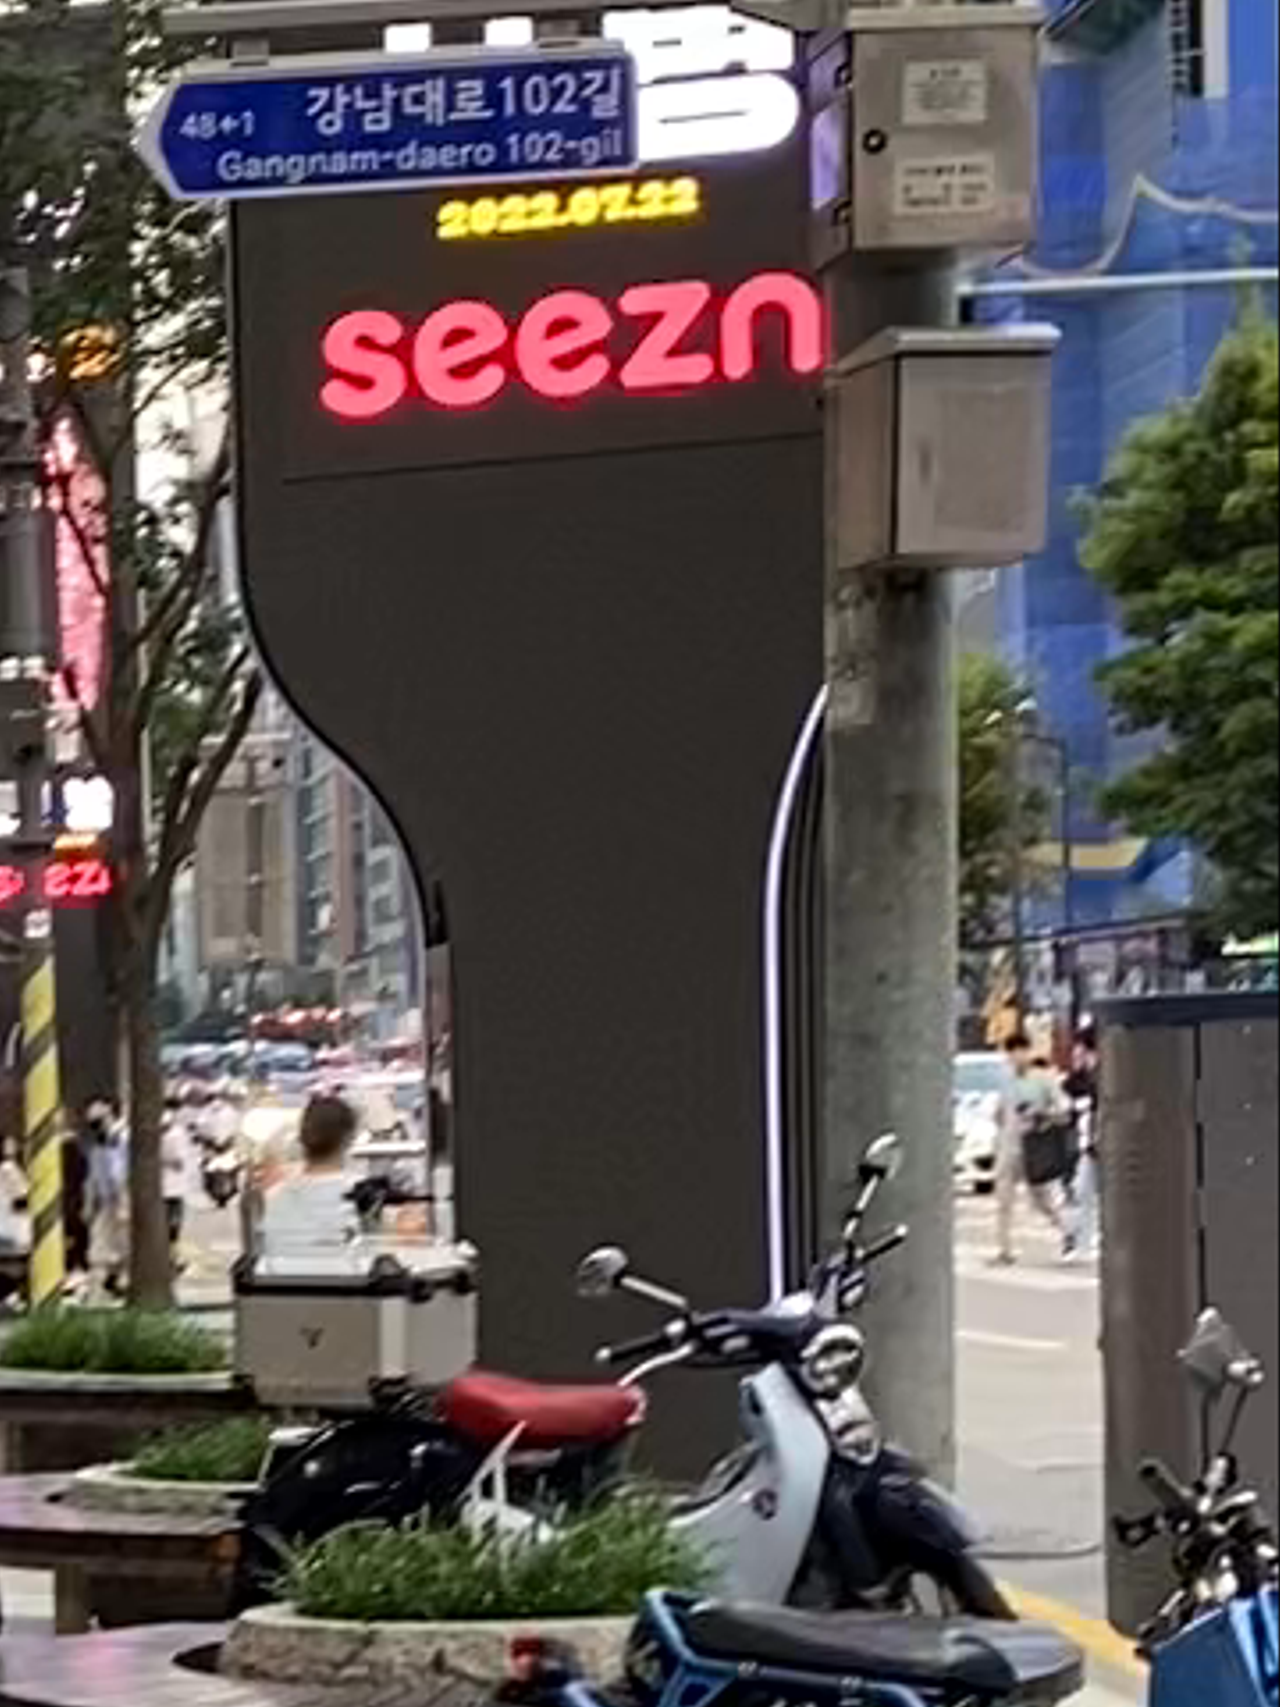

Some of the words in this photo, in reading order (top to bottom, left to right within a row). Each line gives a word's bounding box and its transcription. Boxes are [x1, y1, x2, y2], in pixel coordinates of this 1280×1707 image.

[306, 66, 623, 135] 강남대로102길
[216, 140, 497, 185] Gangnam-daero
[506, 128, 624, 168] 102-gil
[319, 270, 824, 419] seezn
